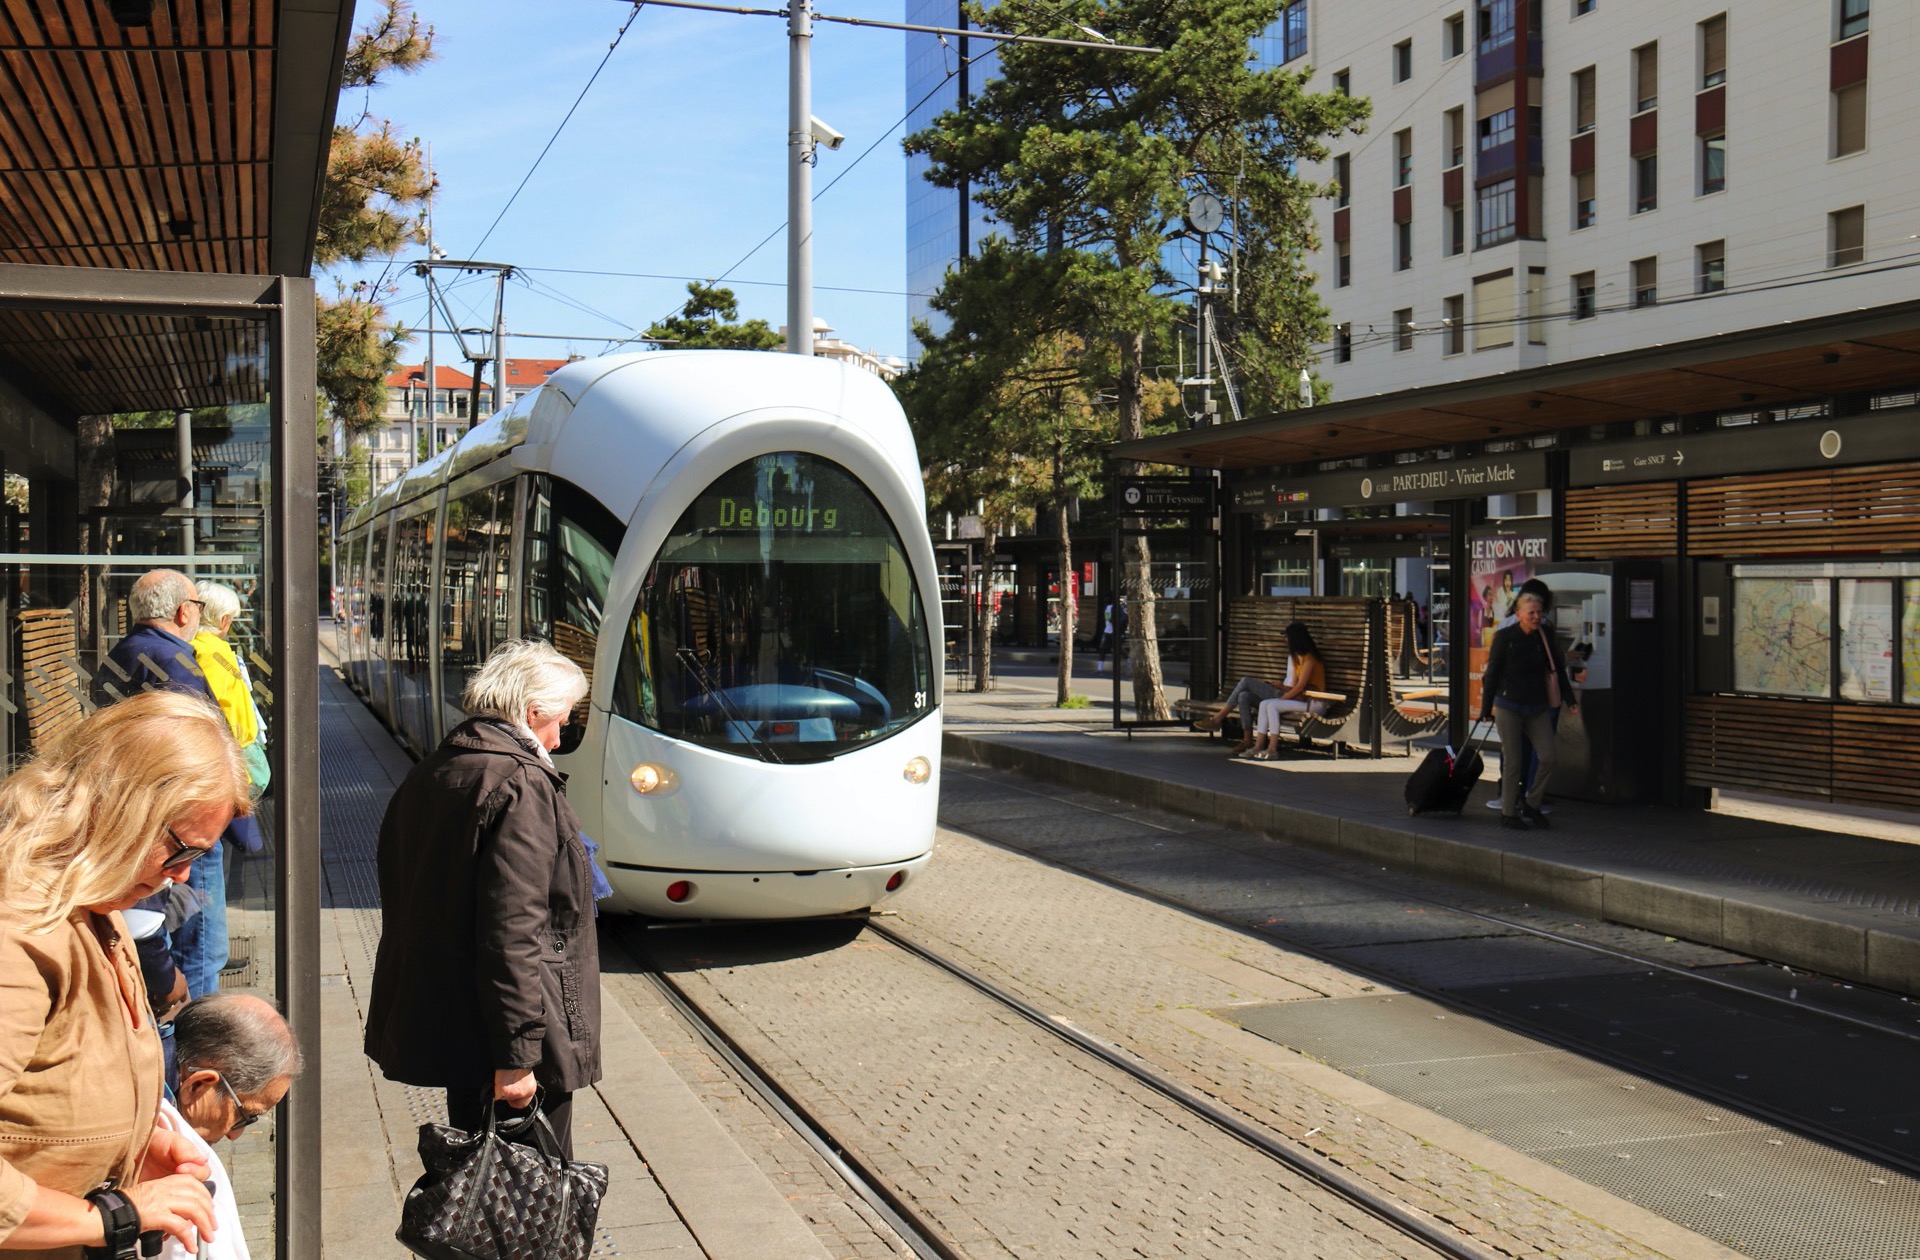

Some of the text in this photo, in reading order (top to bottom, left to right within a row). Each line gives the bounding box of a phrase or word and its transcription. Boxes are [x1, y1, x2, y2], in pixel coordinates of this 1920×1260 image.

[765, 467, 793, 489] T1
[1393, 471, 1448, 491] PART-DIEU
[1456, 468, 1484, 485] Vivier
[1487, 464, 1516, 482] Merle
[1146, 494, 1206, 506] IUT Feyssine
[720, 499, 837, 529] Debourg
[1472, 538, 1547, 558] LE LYON VERT
[1472, 560, 1496, 574] CASINO
[914, 691, 927, 709] 31
